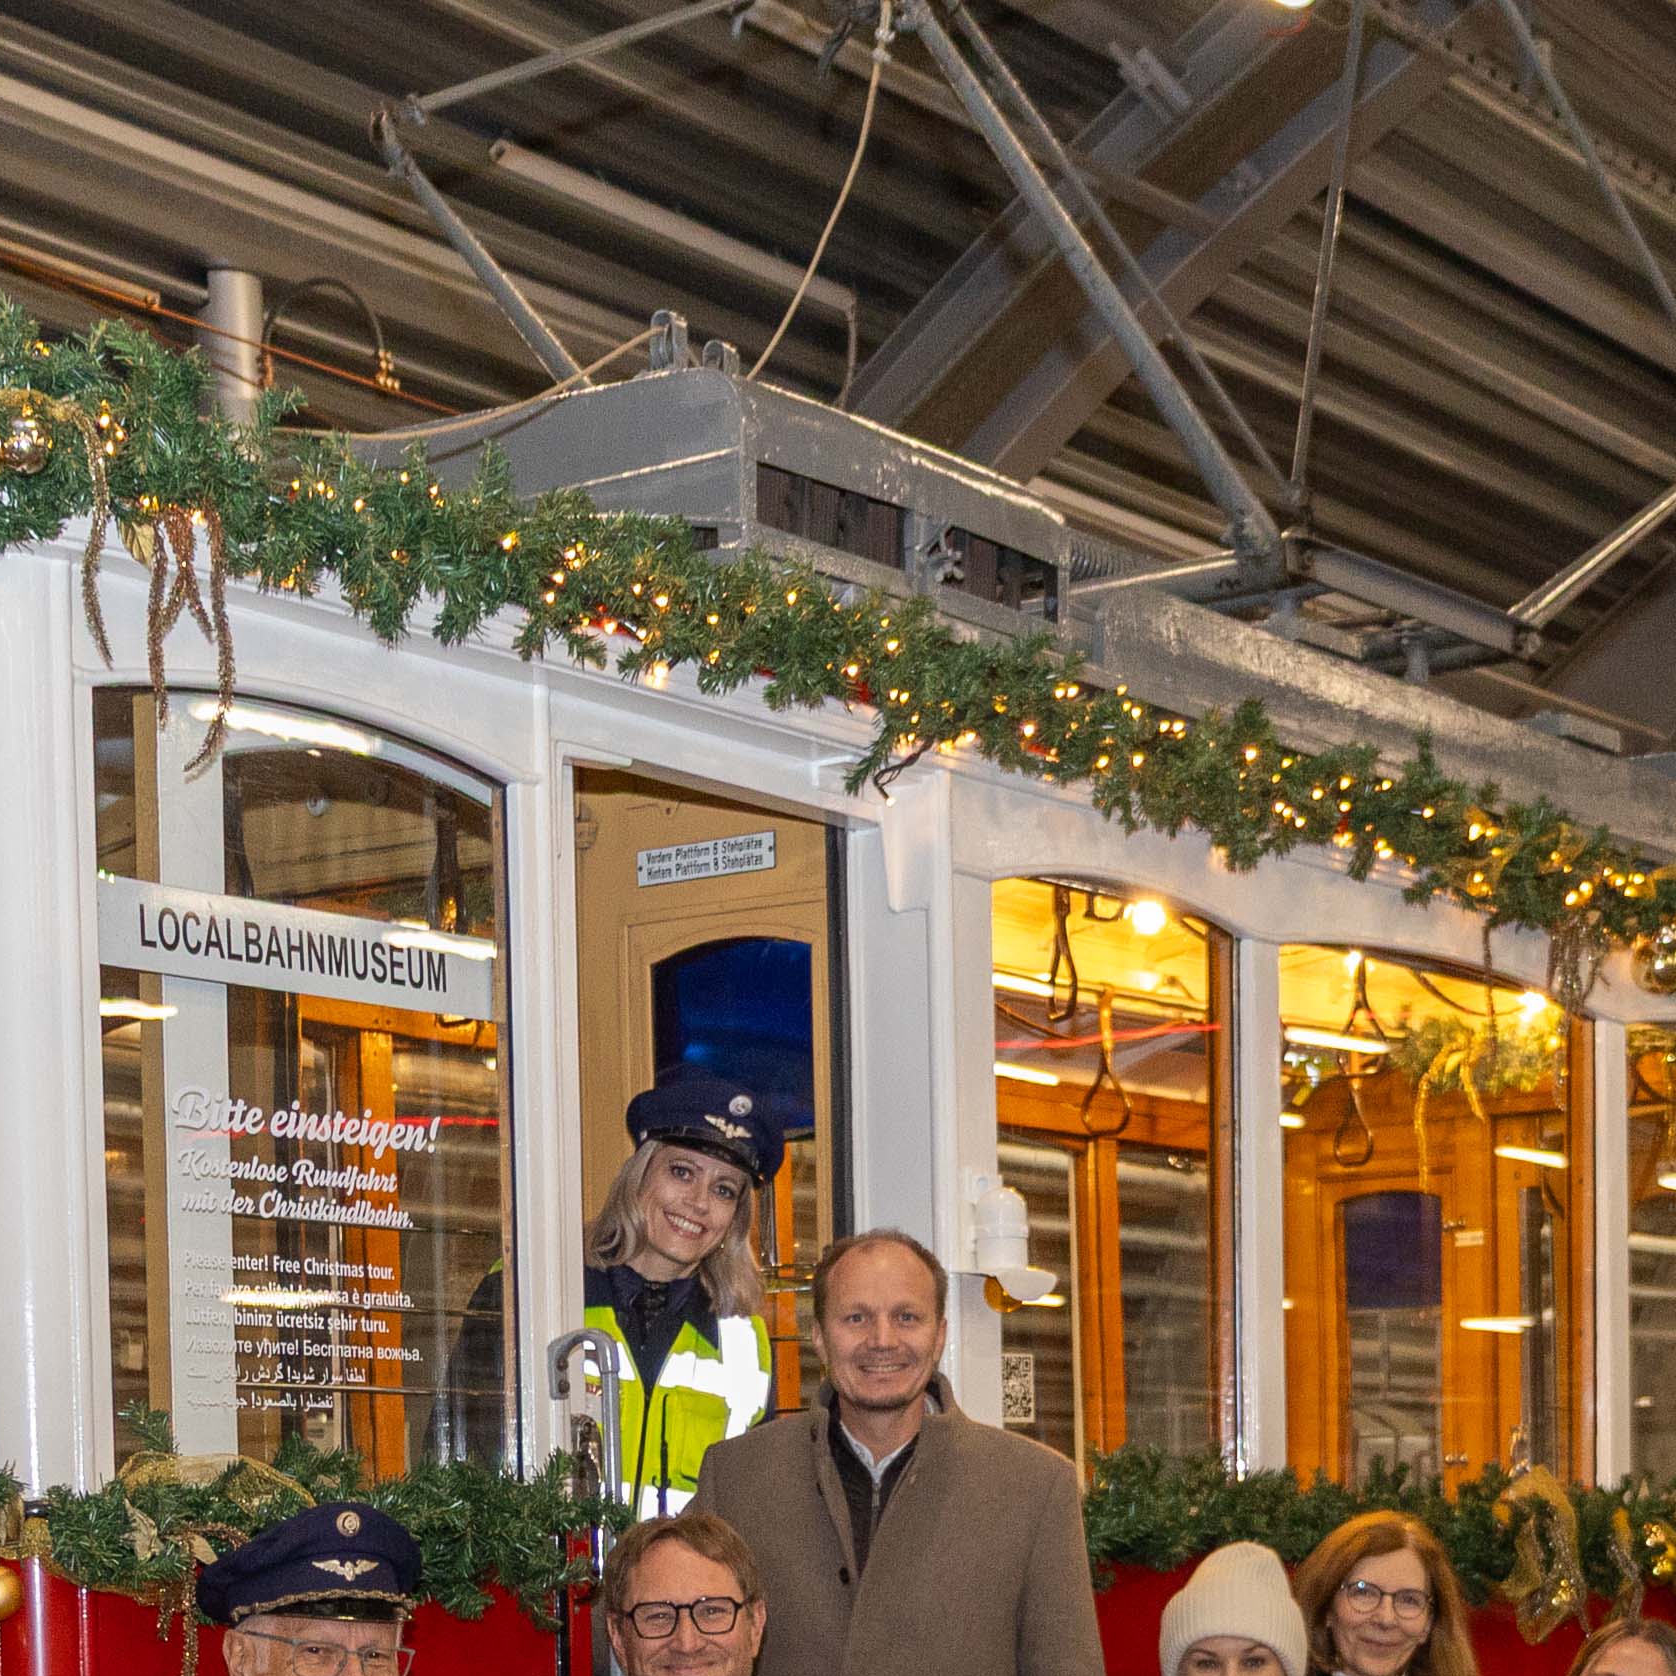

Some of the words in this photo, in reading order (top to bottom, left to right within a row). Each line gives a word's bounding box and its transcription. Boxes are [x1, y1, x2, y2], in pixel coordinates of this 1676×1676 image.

[676, 846, 710, 861] Plattform
[676, 860, 710, 876] Plattform
[139, 903, 447, 993] LOCALBAHNMUSEUM
[172, 1085, 265, 1135] Bitte
[270, 1100, 441, 1159] einsteigen!
[177, 1148, 288, 1182] Kostenlose
[291, 1159, 398, 1196] Rundfahrt
[181, 1187, 218, 1214] mit
[222, 1189, 256, 1216] der
[258, 1189, 415, 1228] Christkindlbahn.
[231, 1253, 269, 1272] enter!
[273, 1256, 300, 1274] Free
[304, 1257, 365, 1279] Christmas
[368, 1264, 395, 1281] tour.
[363, 1291, 415, 1309] gratuita.
[235, 1308, 273, 1327] bininz
[276, 1310, 324, 1330] ücretsiz
[360, 1317, 389, 1333] turu.
[303, 1340, 373, 1359] Бесплатна
